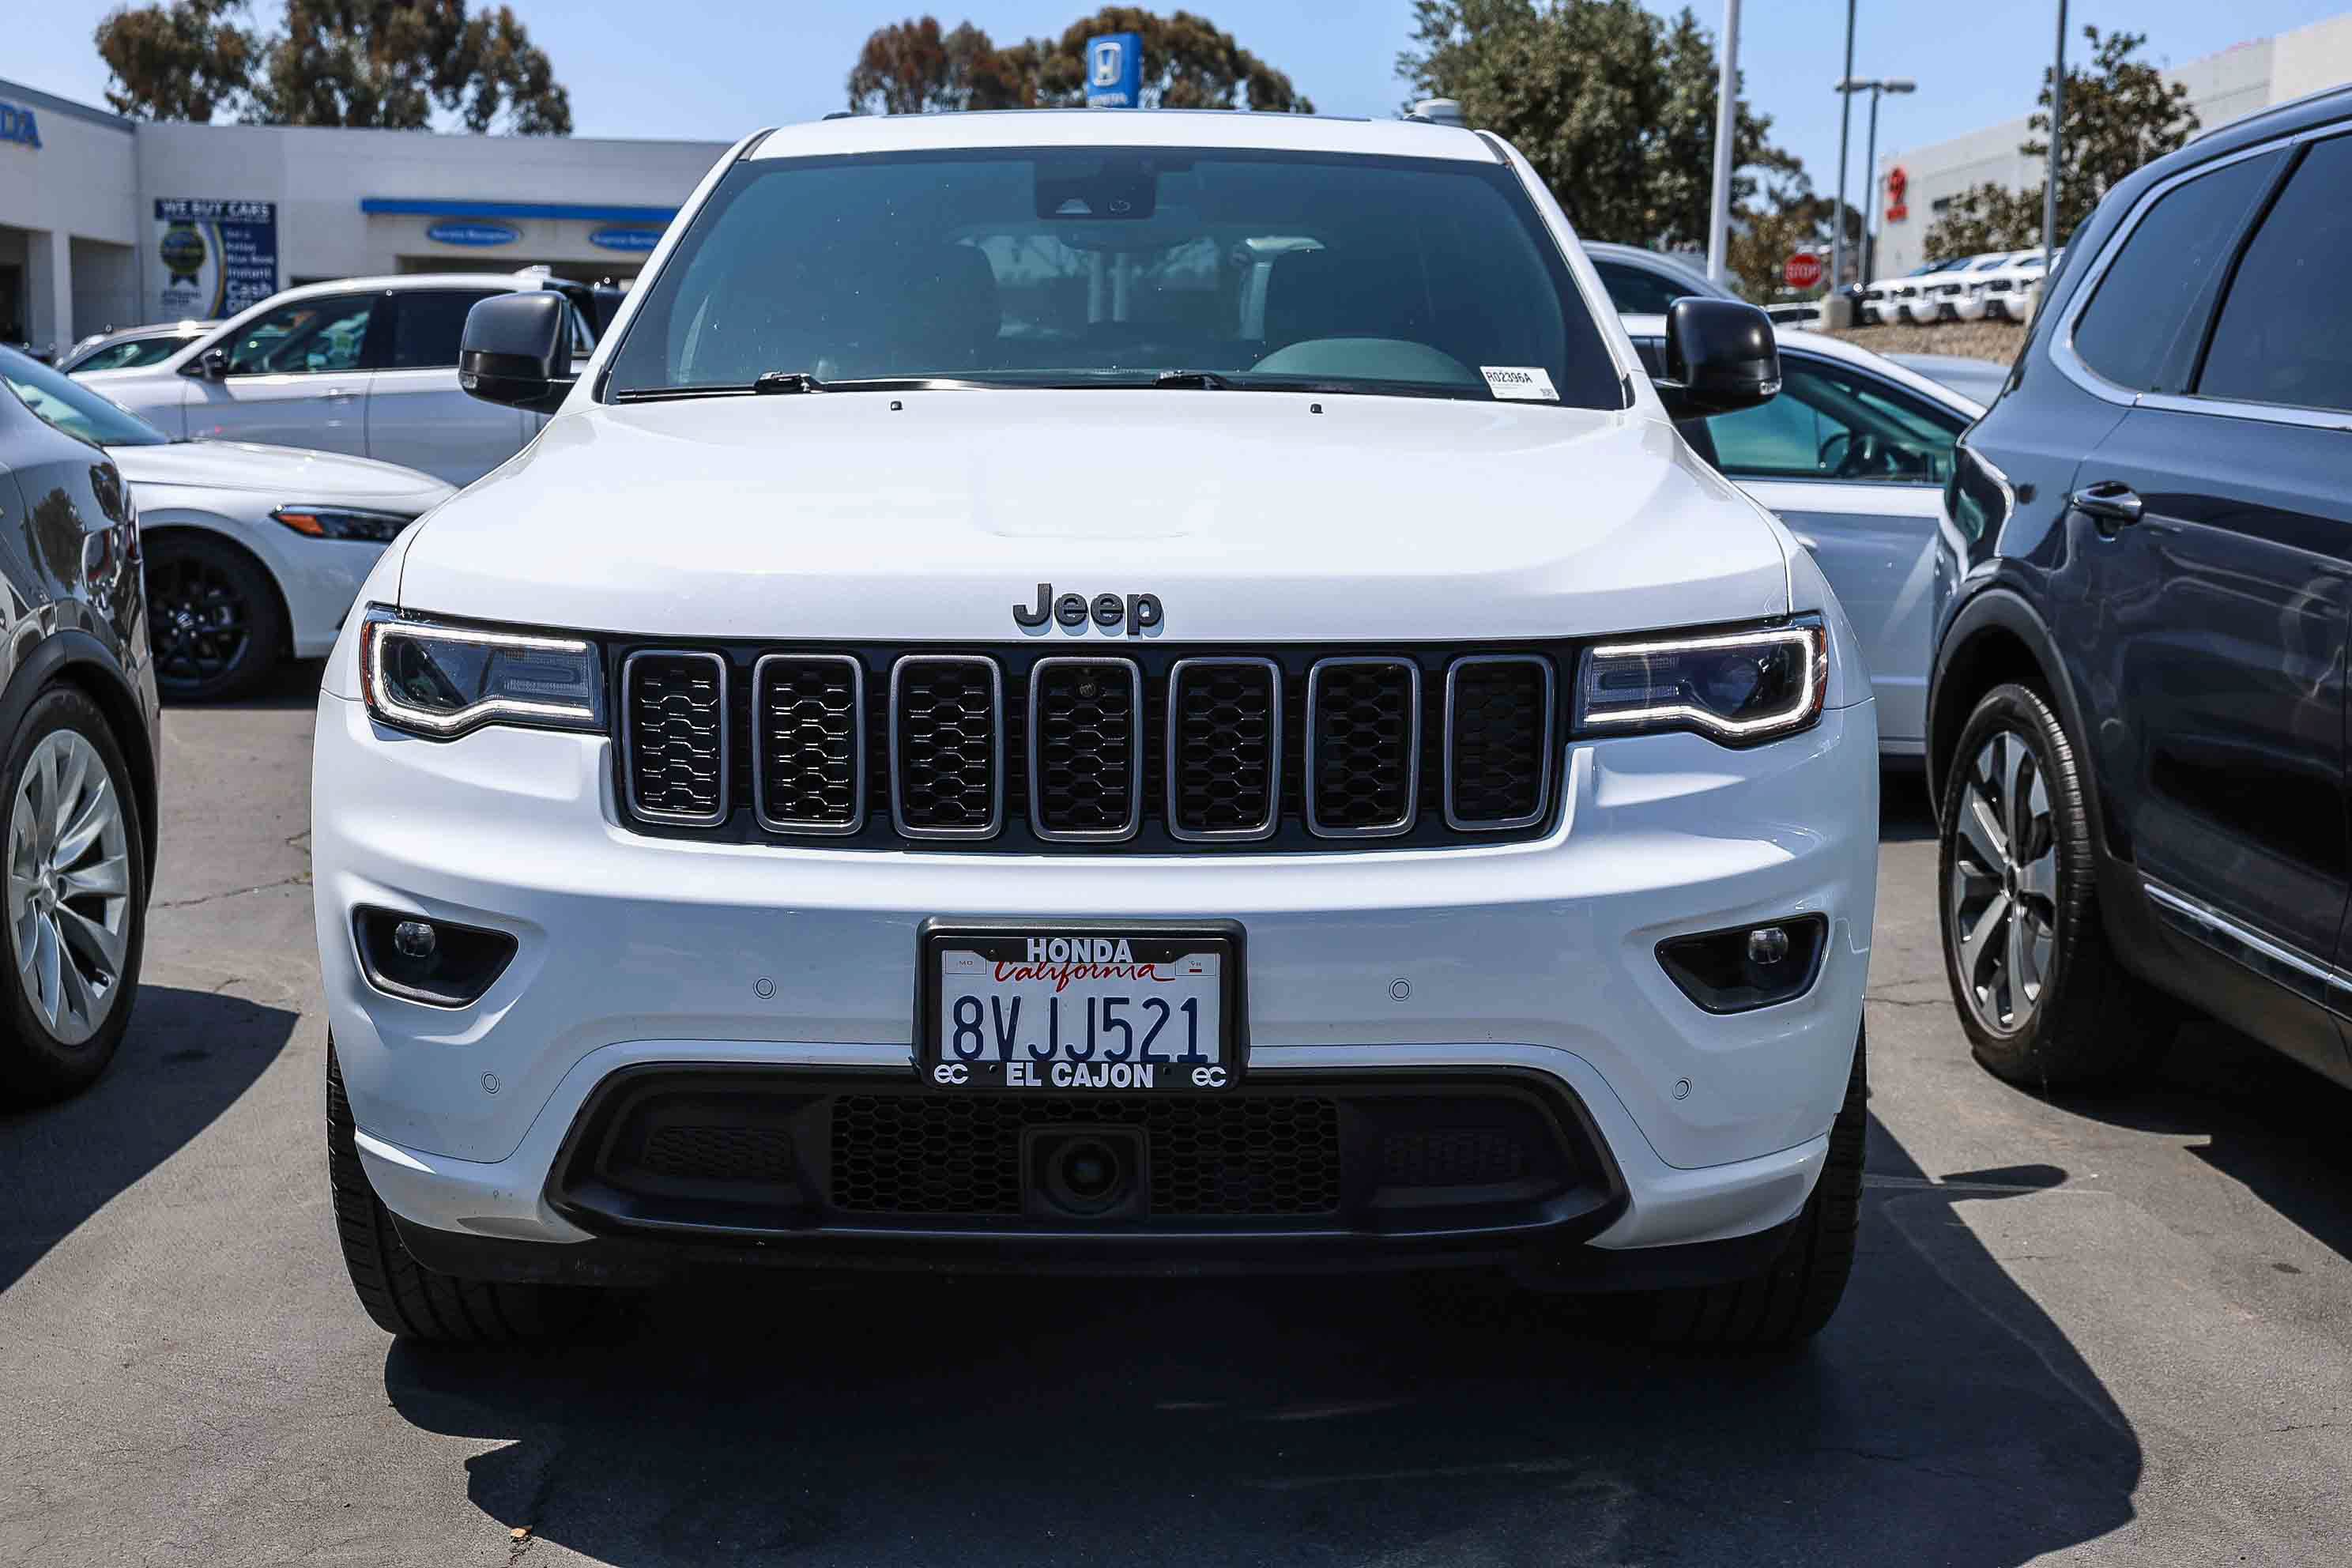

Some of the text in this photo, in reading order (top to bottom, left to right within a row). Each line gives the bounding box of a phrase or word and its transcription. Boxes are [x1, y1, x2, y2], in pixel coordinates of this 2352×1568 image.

[163, 202, 270, 217] WE BUY CARS
[1786, 265, 1819, 278] STOP
[227, 280, 272, 298] Cash
[1012, 582, 1163, 635] Jeep
[1027, 938, 1133, 963] HONDA
[994, 961, 1175, 993] California
[952, 995, 1208, 1062] 8VJJ521
[1006, 1062, 1153, 1088] EL CAJON
